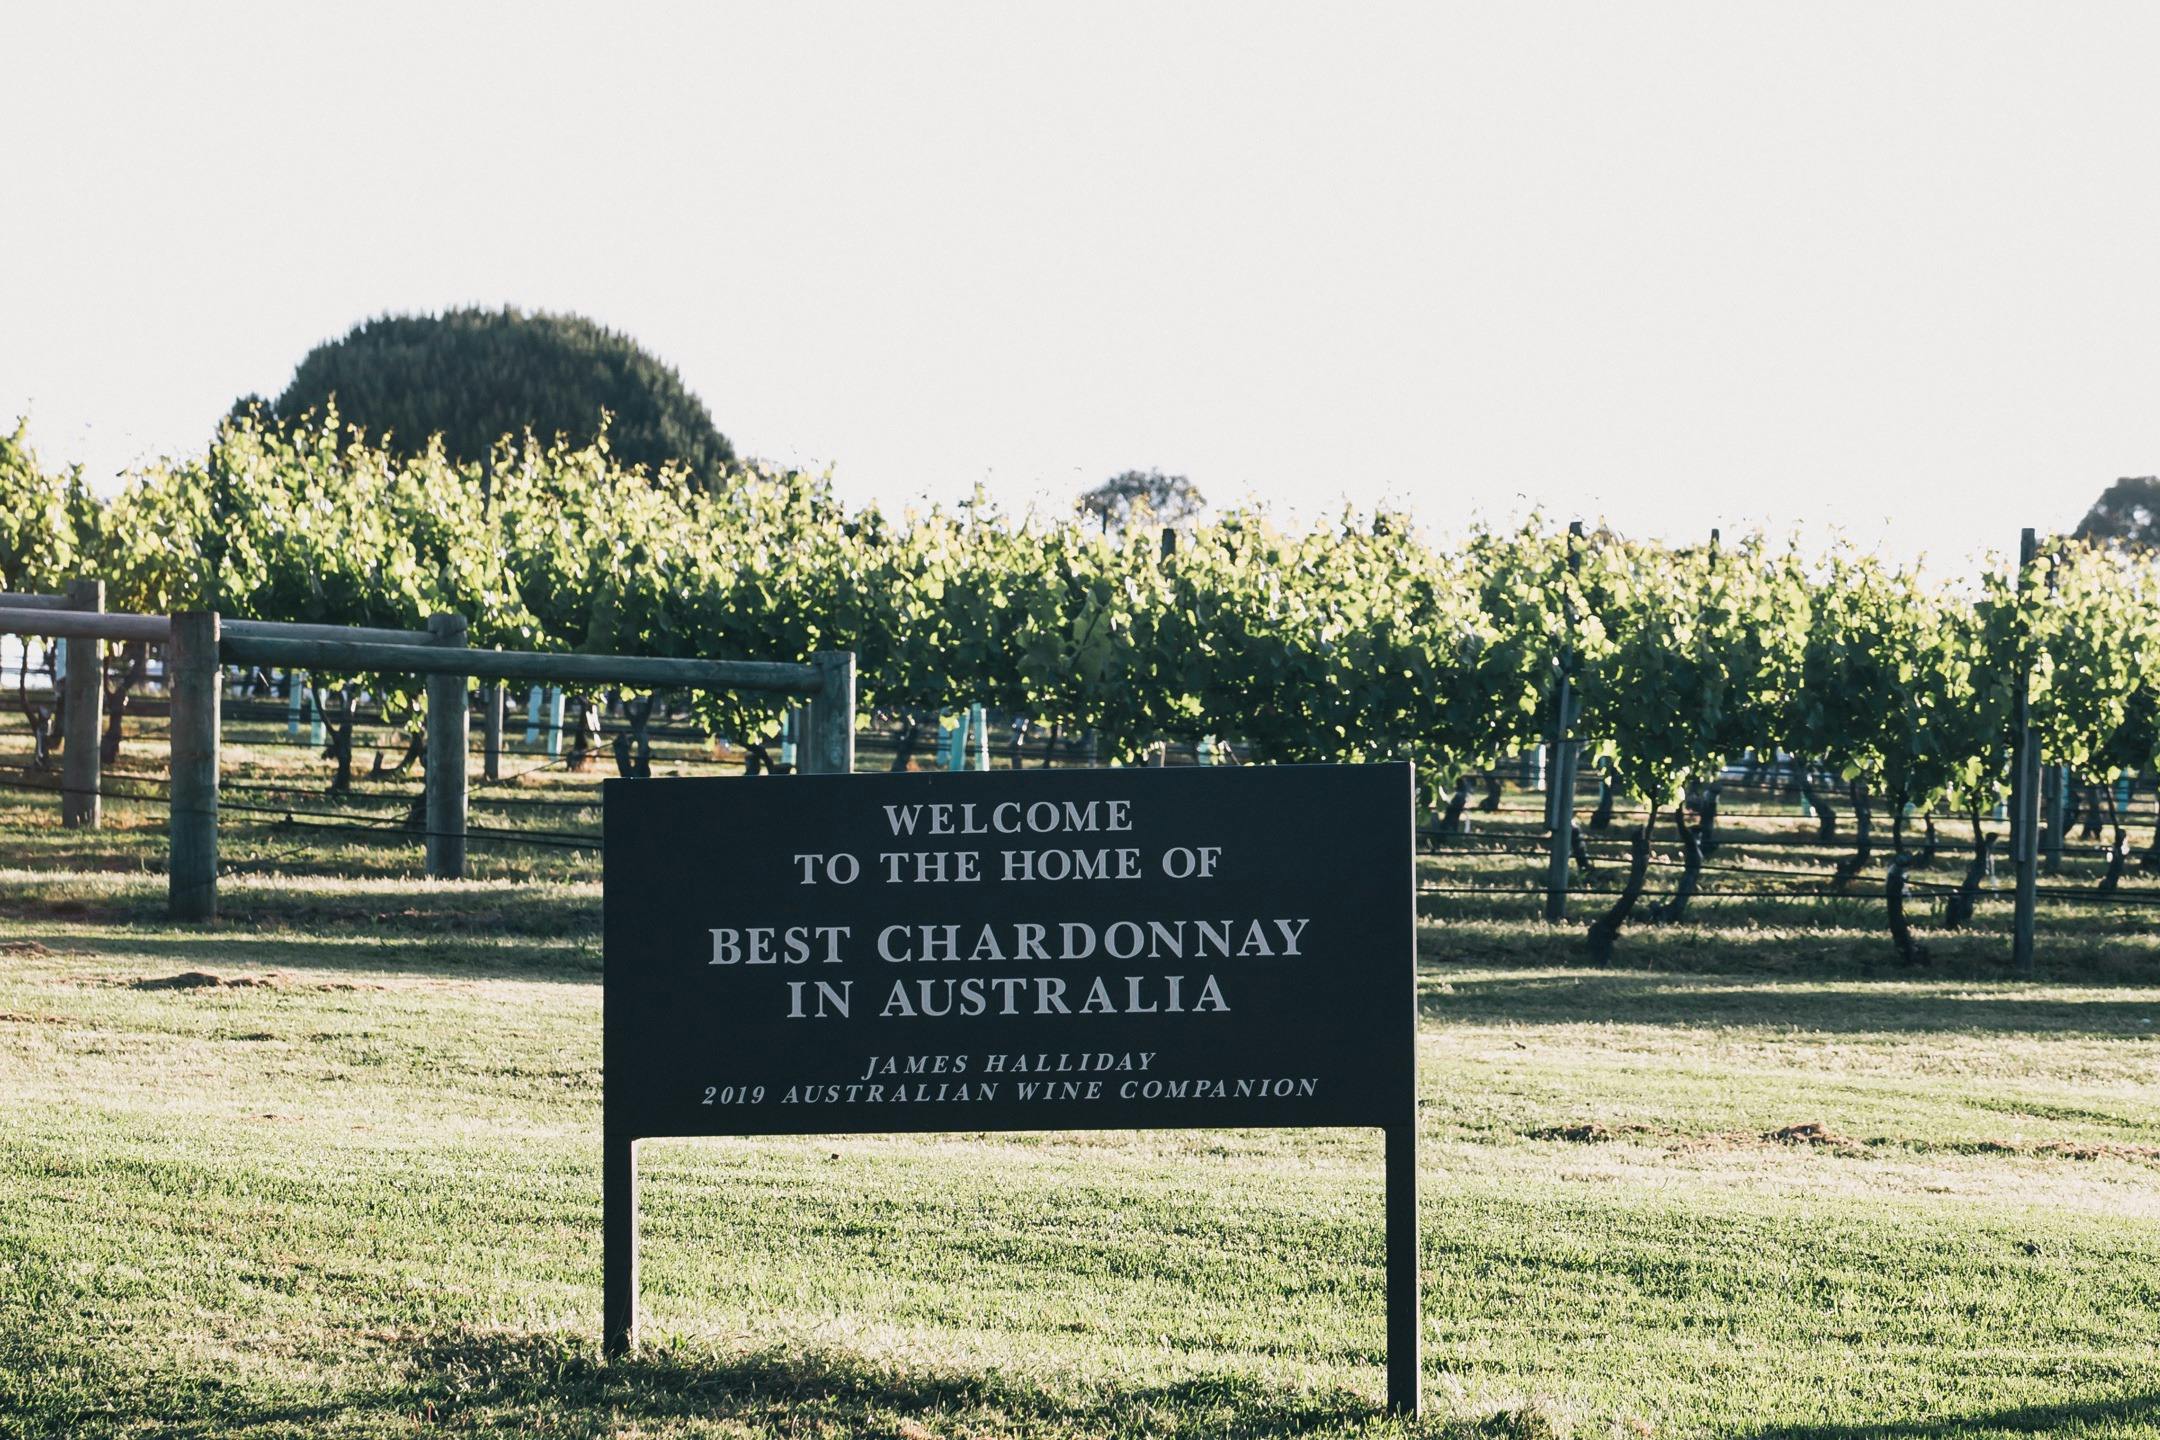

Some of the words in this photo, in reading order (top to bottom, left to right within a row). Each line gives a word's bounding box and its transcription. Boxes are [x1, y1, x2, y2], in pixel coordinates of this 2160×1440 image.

[882, 800, 1133, 836] WELCOME
[794, 853, 860, 885] TO
[879, 851, 981, 883] THE
[1000, 848, 1142, 881] HOME
[1162, 846, 1222, 879] OF
[708, 924, 851, 965] BEST
[877, 918, 1310, 963] CHARDONNAY
[786, 980, 854, 1018] IN
[879, 974, 1231, 1018] AUSTRALIA
[860, 1054, 968, 1081] JAMES
[983, 1052, 1157, 1073] HALLIDAY
[701, 1085, 765, 1105] 2019
[781, 1081, 999, 1104] AUSTRALIAN
[1016, 1081, 1103, 1101] WINE
[1120, 1078, 1319, 1099] COMPANION
